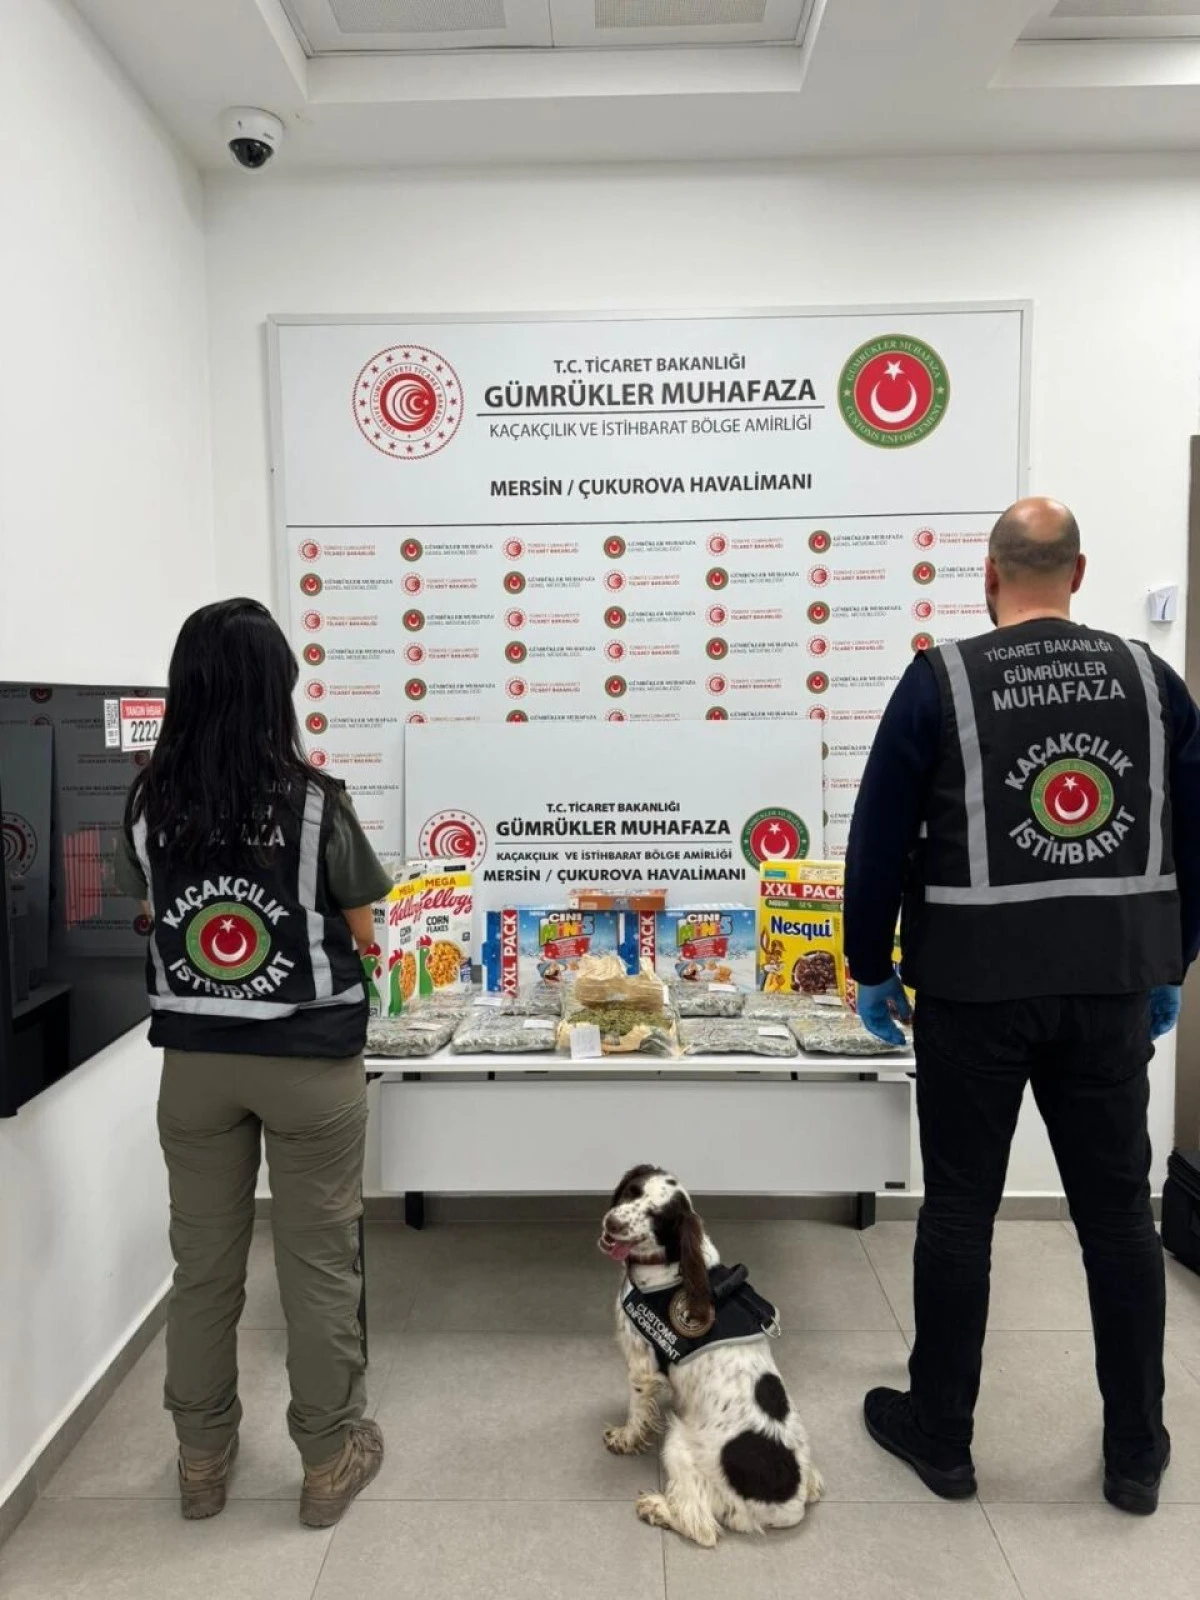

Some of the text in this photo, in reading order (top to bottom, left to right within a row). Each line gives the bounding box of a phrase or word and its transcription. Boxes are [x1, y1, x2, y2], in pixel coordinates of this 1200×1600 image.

[553, 352, 746, 374] T.C. TİCARET BAKANLIĞI
[484, 378, 817, 408] GÜMRÜKLER MUHAFAZA
[489, 413, 812, 441] KAÇAKÇILIK VE İSTİHBARAT BÖLGE AMİRLİĞİ
[490, 470, 812, 499] MERSİN / ÇUKUROVA HAVALİMANI
[985, 638, 1113, 663] TİCARET BAKANLIĞI
[1003, 659, 1108, 685] GÜMRÜKLER
[991, 678, 1126, 711] MUHAFAZA
[130, 719, 159, 743] 2222
[1004, 732, 1134, 791] KAÇAKÇILIK
[546, 800, 681, 813] T.C. TİCARET BAKANLIĞI
[496, 816, 616, 836] GÜMRÜKLER
[620, 819, 731, 836] MUHAFAZA
[1008, 805, 1136, 865] İSTİHBARAT
[496, 848, 733, 864] KAÇAKÇILIK VE İSTİHBARAT BÖLGE AMİRLİĞİ
[424, 876, 457, 887] MEGA
[483, 864, 746, 885] MERSİN / ÇUKUROVA HAVALİMANI
[161, 875, 291, 930] KAÇAKÇILIK
[764, 882, 845, 900] XXL PACK
[549, 912, 583, 924] CINI
[686, 913, 721, 925] CINI
[641, 914, 655, 957] PACK
[503, 912, 517, 995] XXL PACK
[624, 1301, 681, 1360] ENFORCEMENT
[636, 1303, 678, 1345] CUSTOMS
